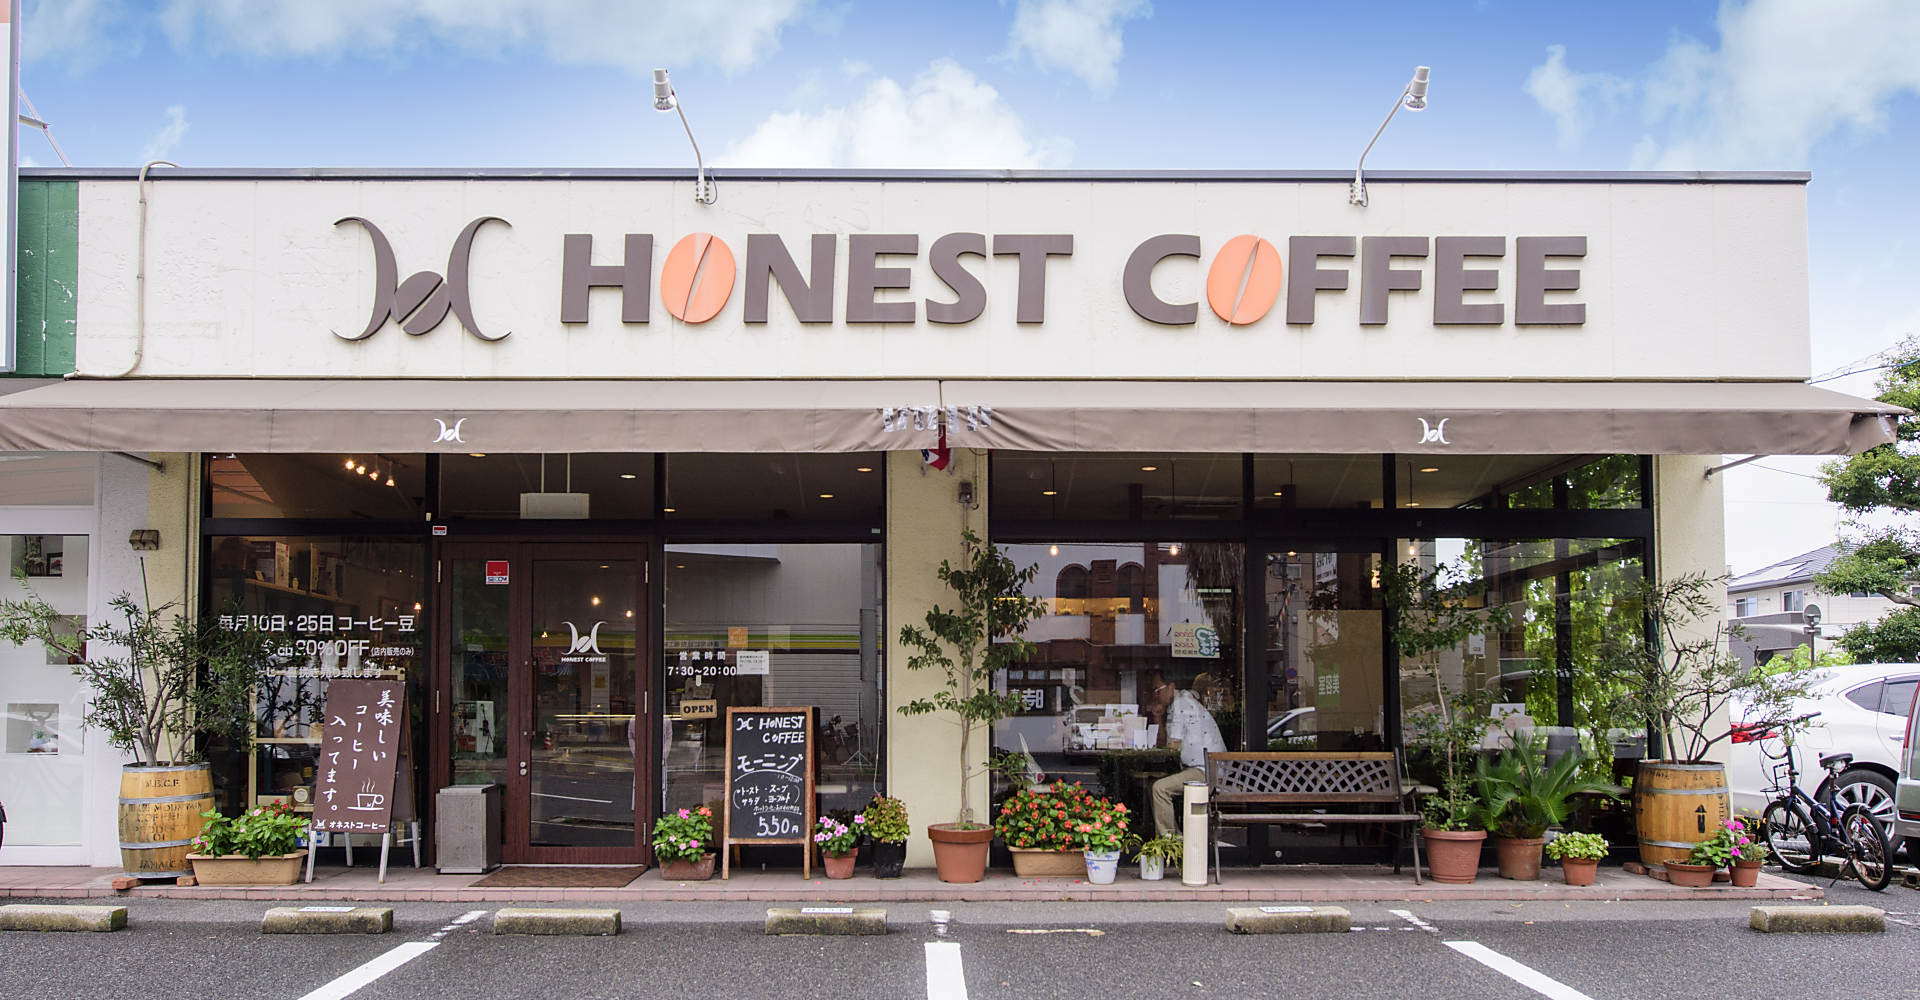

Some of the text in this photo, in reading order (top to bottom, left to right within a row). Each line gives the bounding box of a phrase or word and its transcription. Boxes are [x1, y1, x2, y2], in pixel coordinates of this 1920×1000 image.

[560, 232, 1588, 326] HONEST COFFEE
[679, 651, 726, 661] 営業時間
[683, 705, 714, 714] OPEN
[372, 690, 396, 762] 美味しい
[759, 716, 805, 730] HONEST
[352, 705, 368, 770] コーヒー
[762, 732, 805, 744] COFFEE
[322, 715, 347, 811] 入ってます。
[737, 753, 804, 773] モーニング
[328, 821, 386, 830] オネストコーヒー
